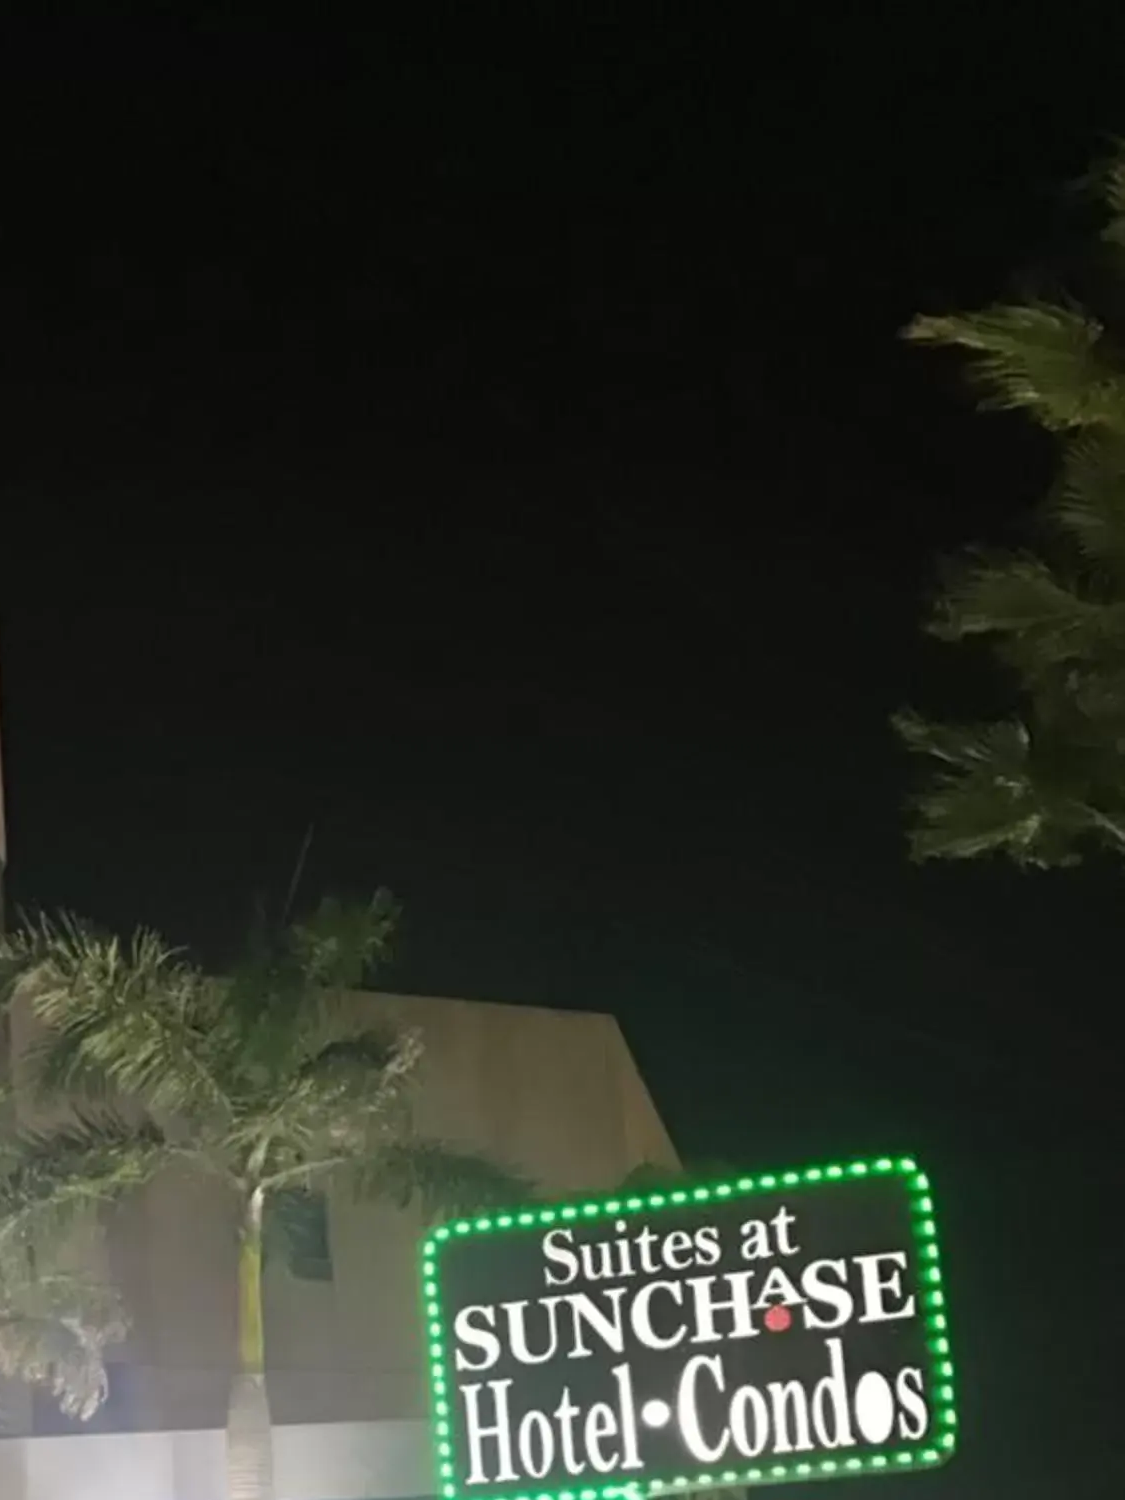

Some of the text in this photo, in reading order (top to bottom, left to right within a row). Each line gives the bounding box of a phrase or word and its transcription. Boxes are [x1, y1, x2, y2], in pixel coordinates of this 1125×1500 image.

[542, 1205, 801, 1287] Suites at
[452, 1251, 917, 1373] SUNCHASE
[459, 1361, 645, 1486] Hotel
